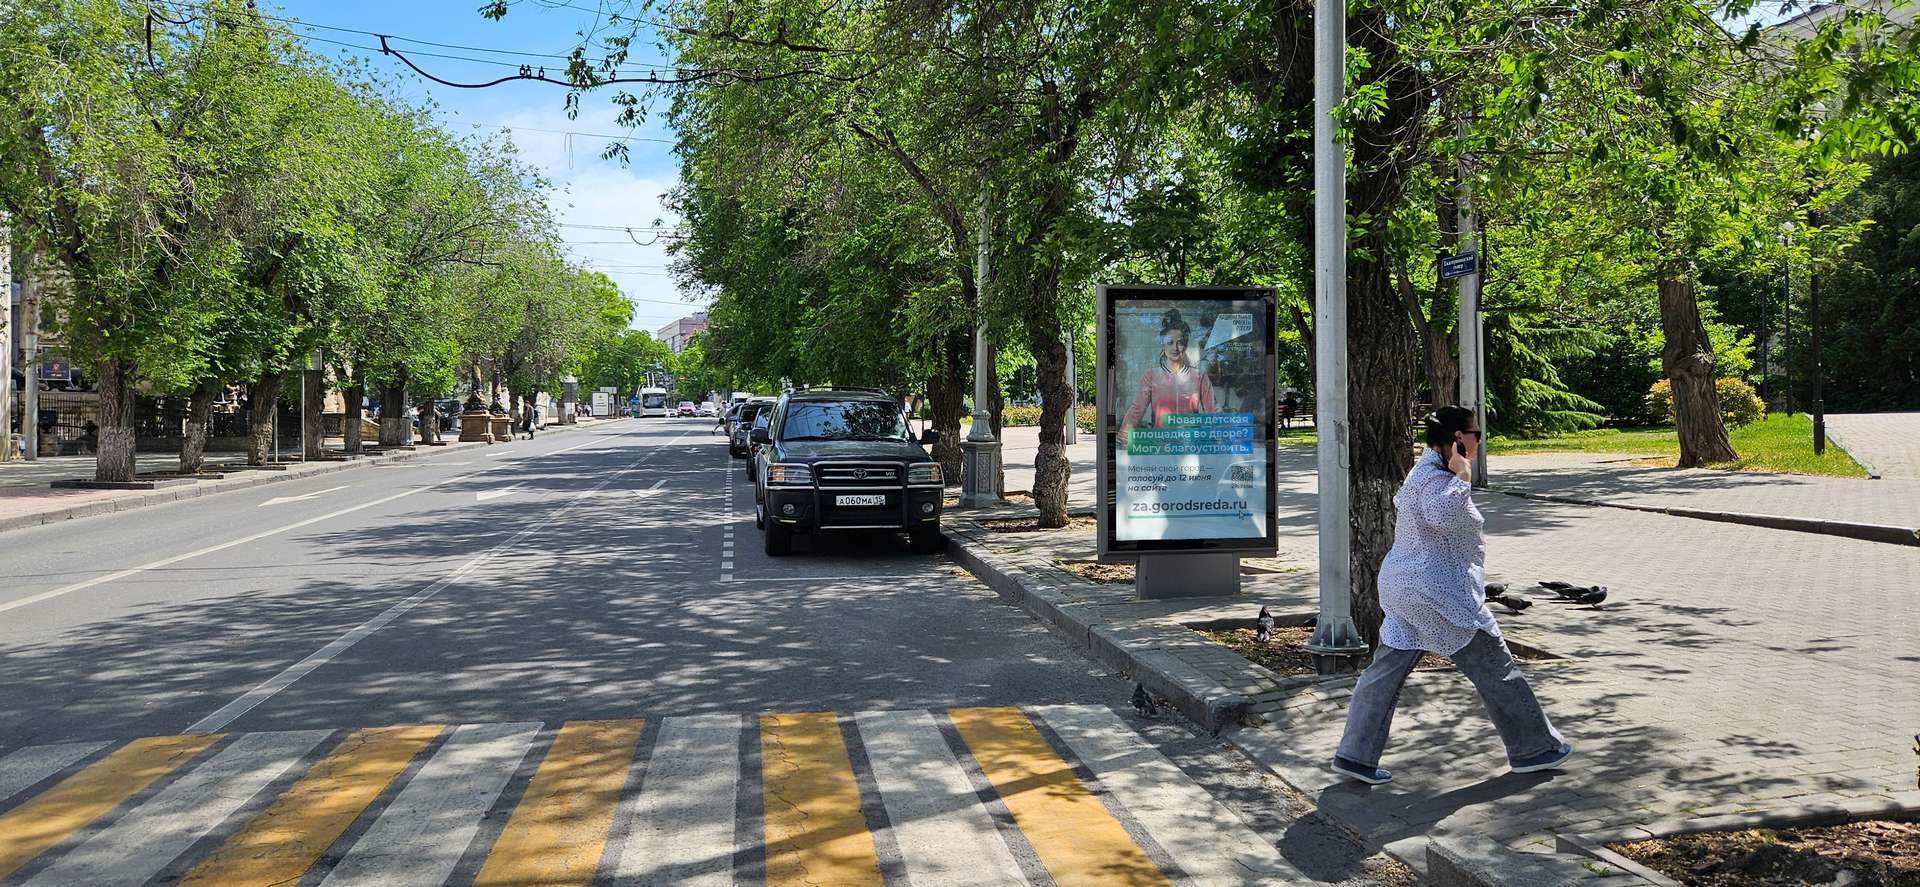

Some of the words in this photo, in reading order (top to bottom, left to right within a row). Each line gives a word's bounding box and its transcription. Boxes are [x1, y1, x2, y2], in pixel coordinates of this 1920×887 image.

[1167, 415, 1202, 424] Новая
[1204, 415, 1249, 425] детская
[1133, 430, 1190, 439] площадка
[1209, 428, 1249, 439] дворе?
[1132, 444, 1162, 454] Могу
[1164, 442, 1249, 453] благоустроить.
[1128, 465, 1158, 473] Меняй
[1128, 474, 1164, 483] голосуй
[1165, 475, 1177, 483] до
[1141, 484, 1168, 492] сайте
[1132, 499, 1247, 513] za.gorodsreda.ru
